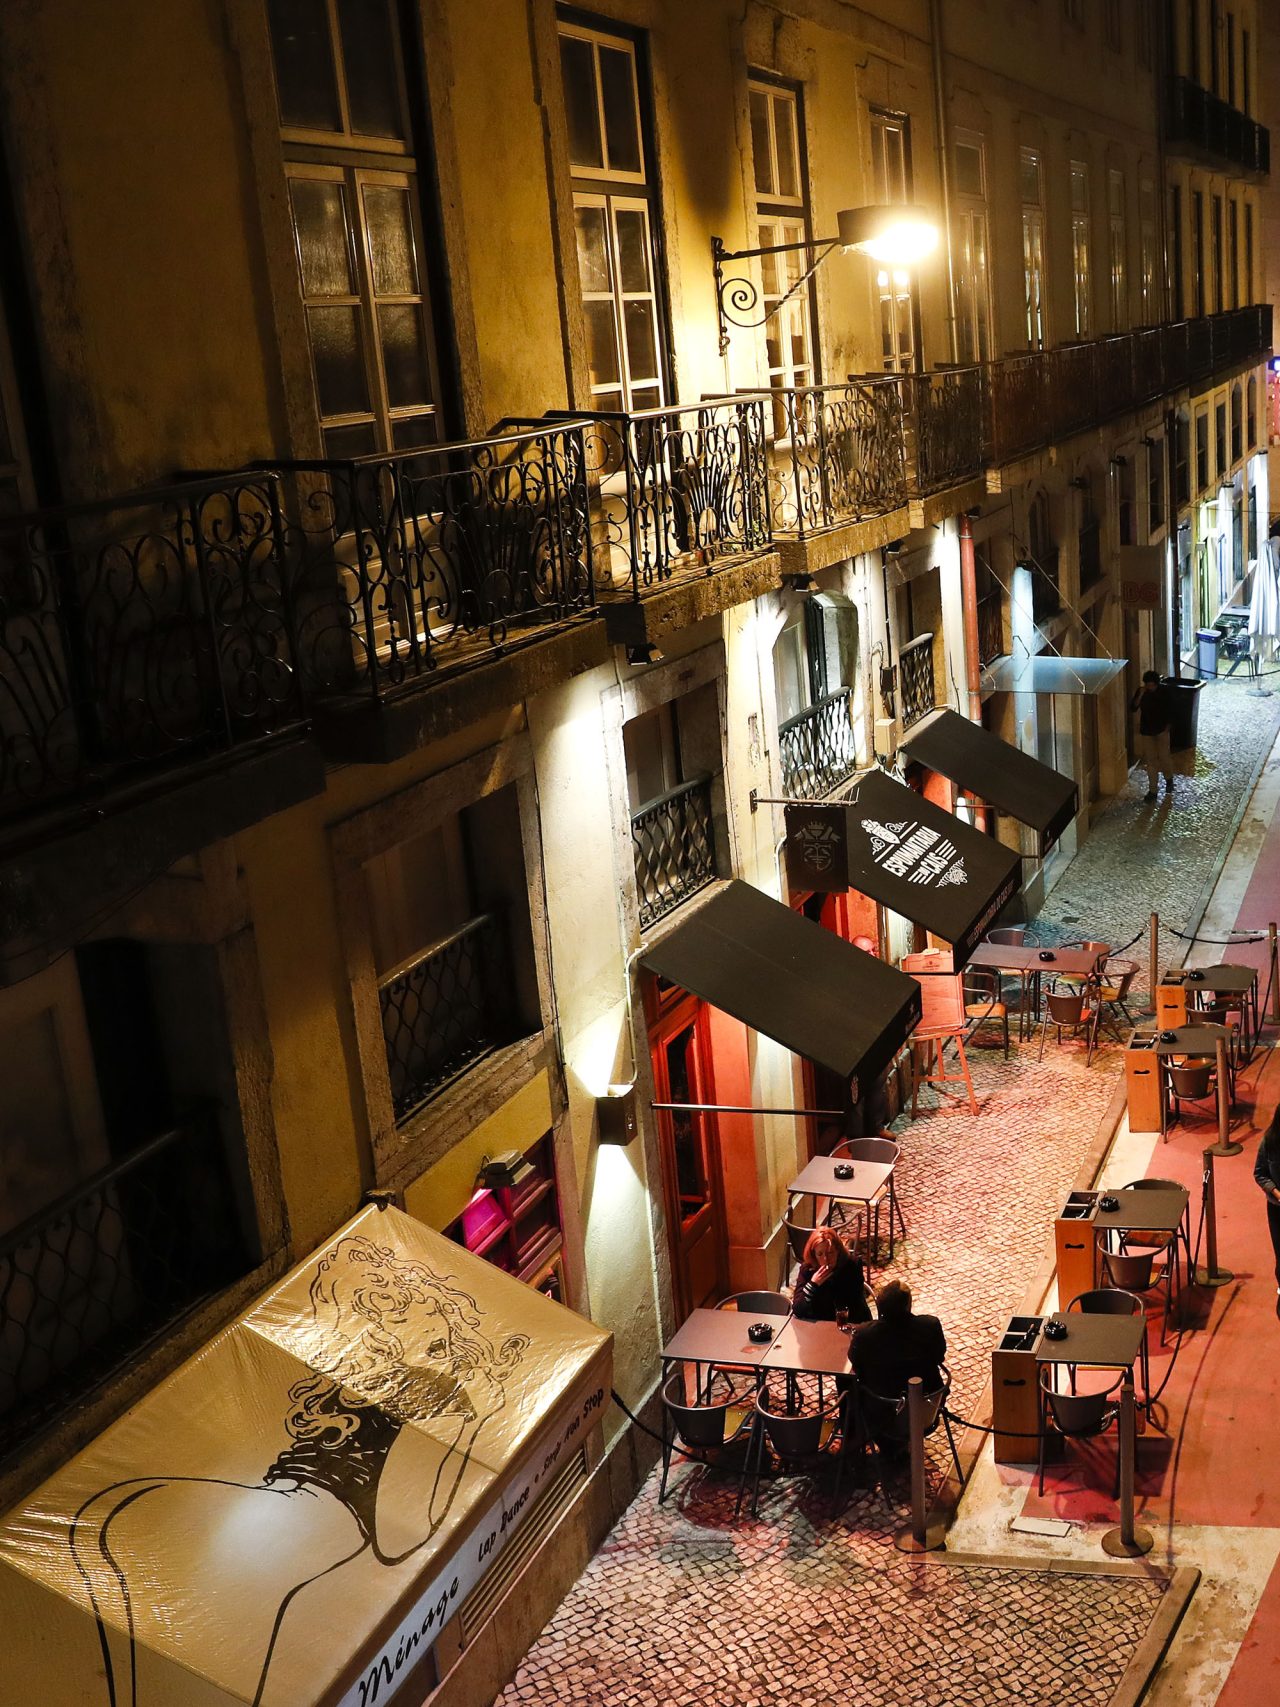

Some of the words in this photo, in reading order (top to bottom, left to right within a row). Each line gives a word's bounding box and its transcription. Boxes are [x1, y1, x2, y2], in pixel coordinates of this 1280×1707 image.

[882, 825, 941, 877] ESPUMANTARIA
[920, 852, 949, 875] CAIS
[358, 1576, 460, 1707] Ménage
[478, 1531, 497, 1562] Lap
[500, 1486, 530, 1532] Dance
[583, 1388, 604, 1418] Stop
